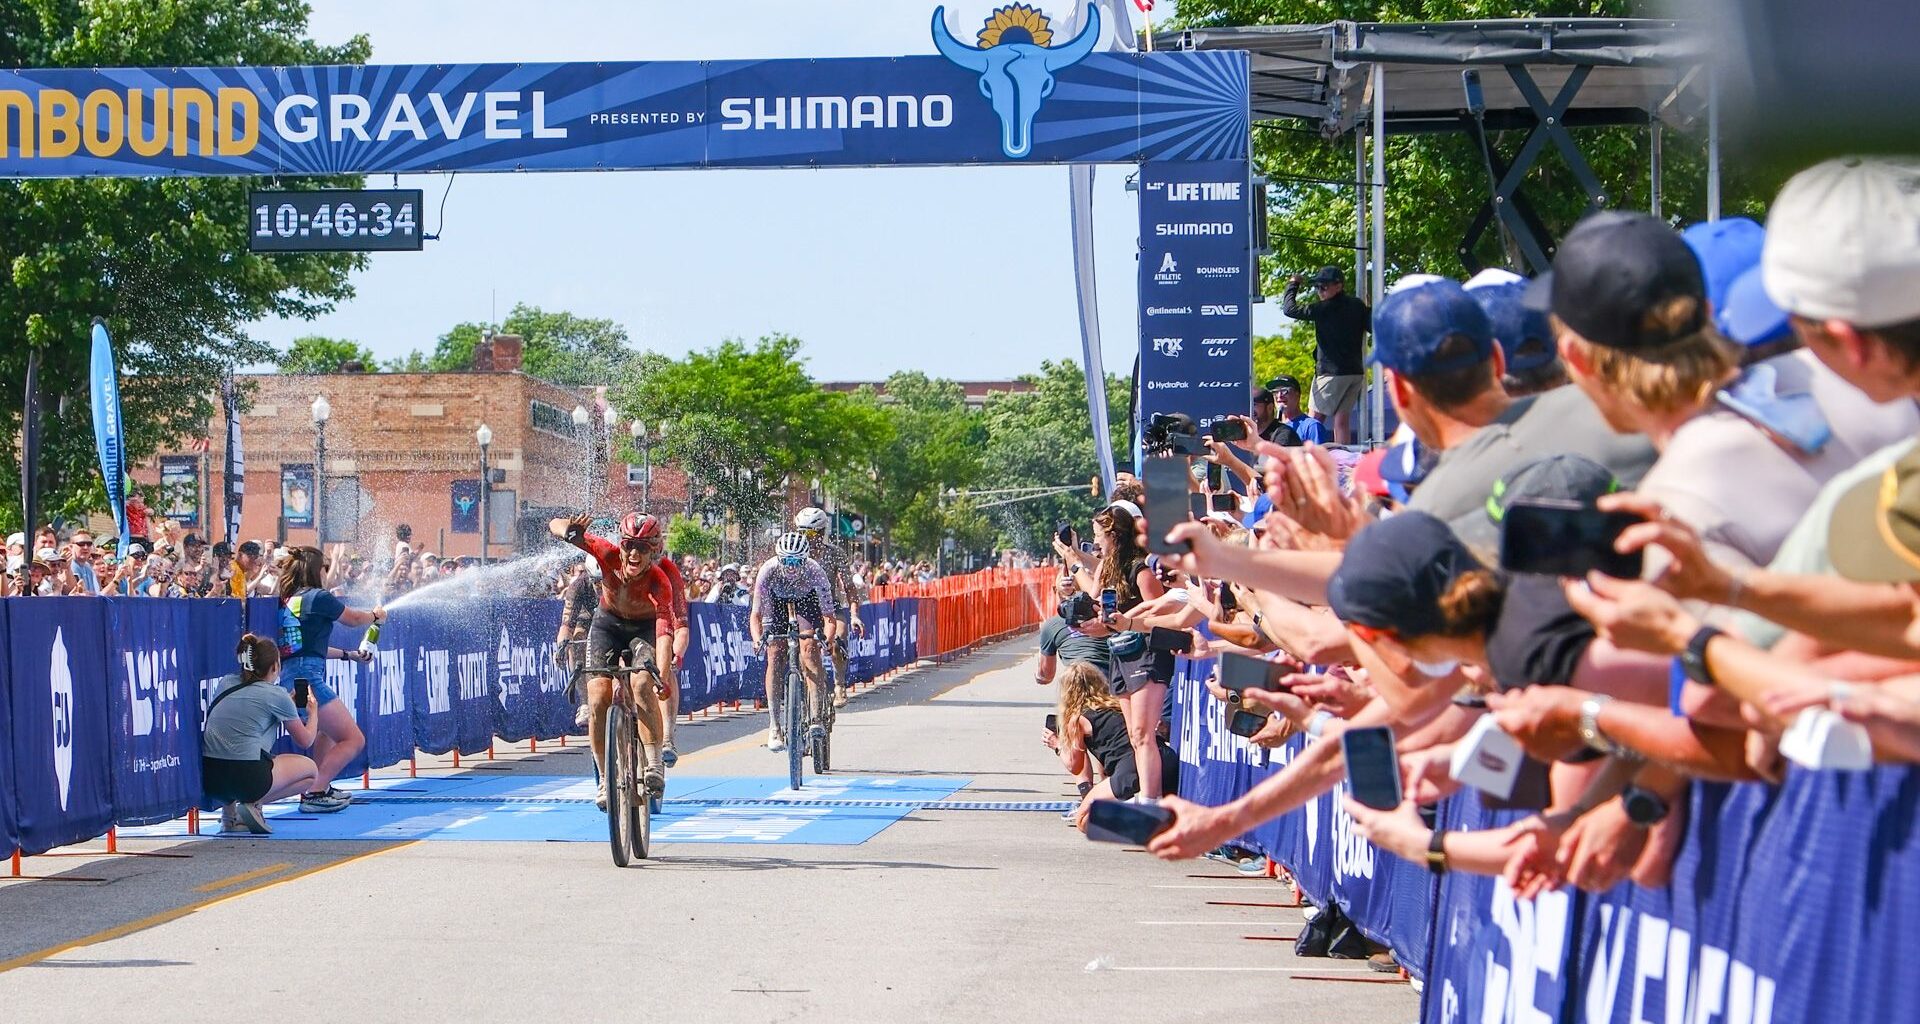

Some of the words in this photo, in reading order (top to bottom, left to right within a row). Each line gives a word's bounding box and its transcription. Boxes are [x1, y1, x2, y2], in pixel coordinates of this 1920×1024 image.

[273, 91, 568, 143] GRAVEL
[590, 112, 679, 125] PRESENTED
[687, 112, 705, 124] BY
[721, 94, 953, 131] SHIMANO
[254, 202, 417, 239] 10:46:34
[1155, 223, 1233, 236] SHIMANO
[1154, 273, 1182, 281] ATHLETIC
[1196, 266, 1240, 275] BOUNDLESS
[1152, 338, 1183, 357] FOX
[104, 373, 117, 436] GRAVEL
